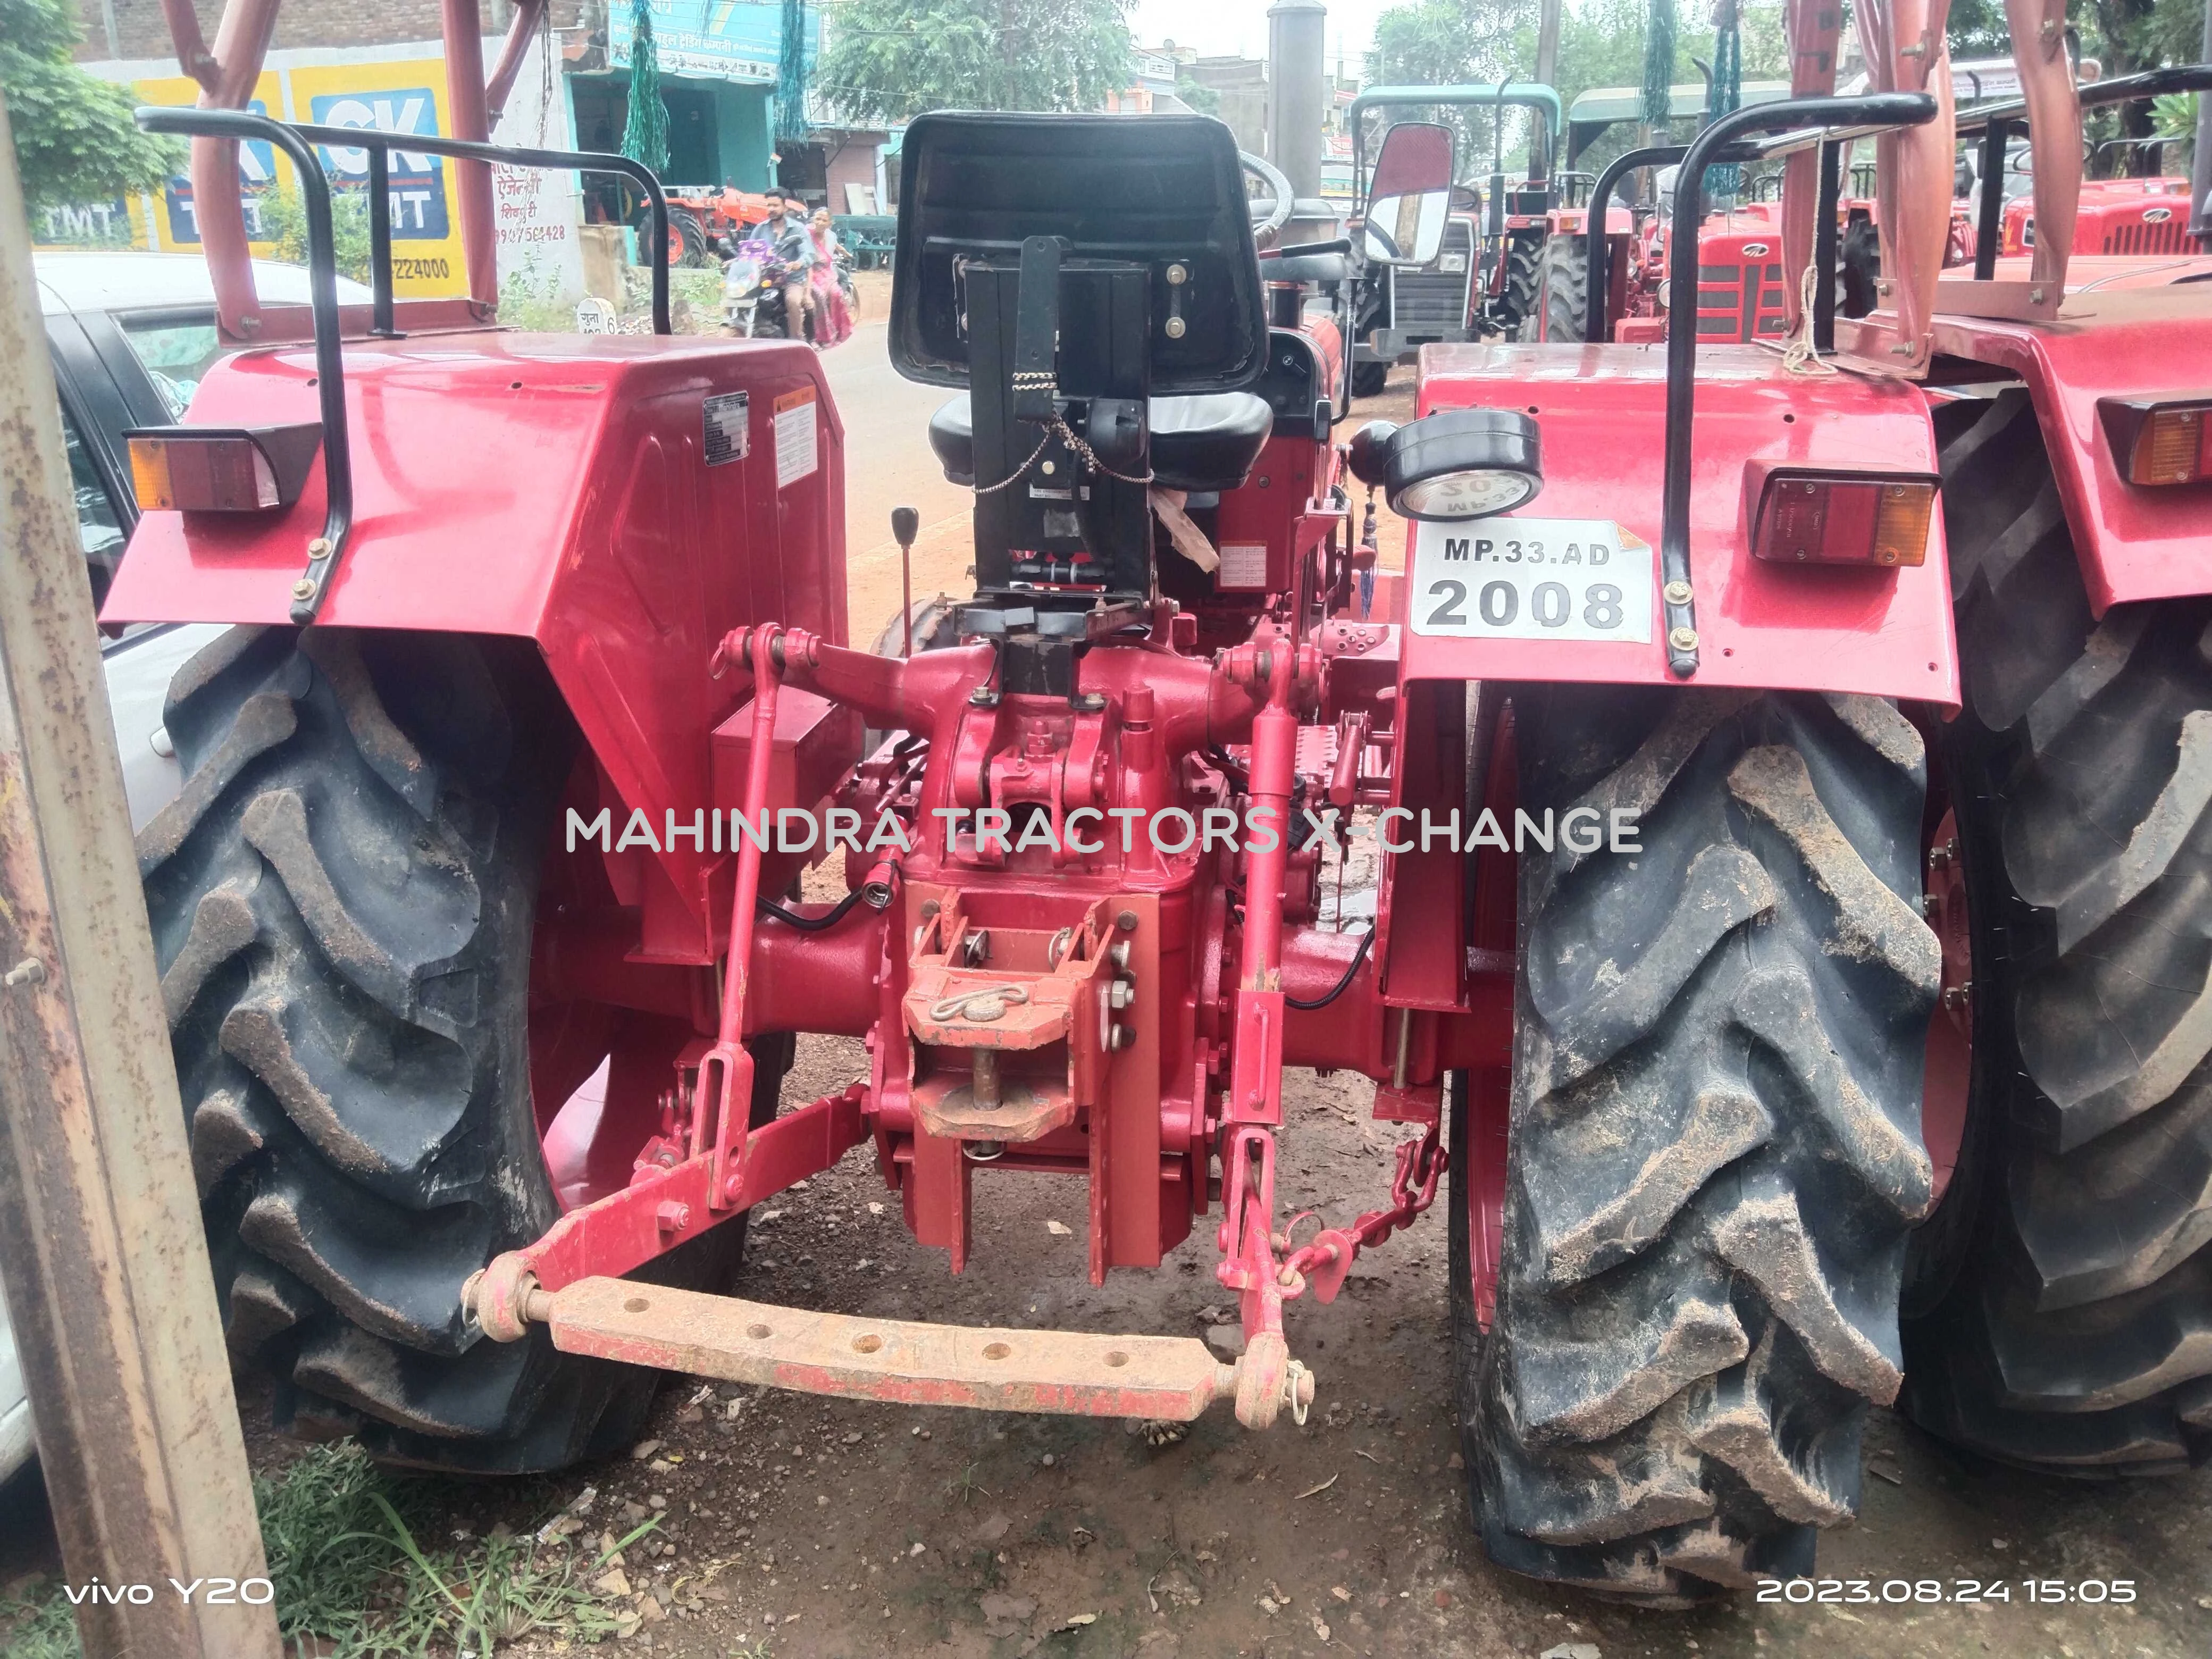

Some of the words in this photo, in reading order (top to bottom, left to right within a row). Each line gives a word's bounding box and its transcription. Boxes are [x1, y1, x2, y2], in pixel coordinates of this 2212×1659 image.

[580, 313, 599, 326] गुना
[1444, 538, 1610, 565] MP.33.AD
[1426, 580, 1624, 629] 2008
